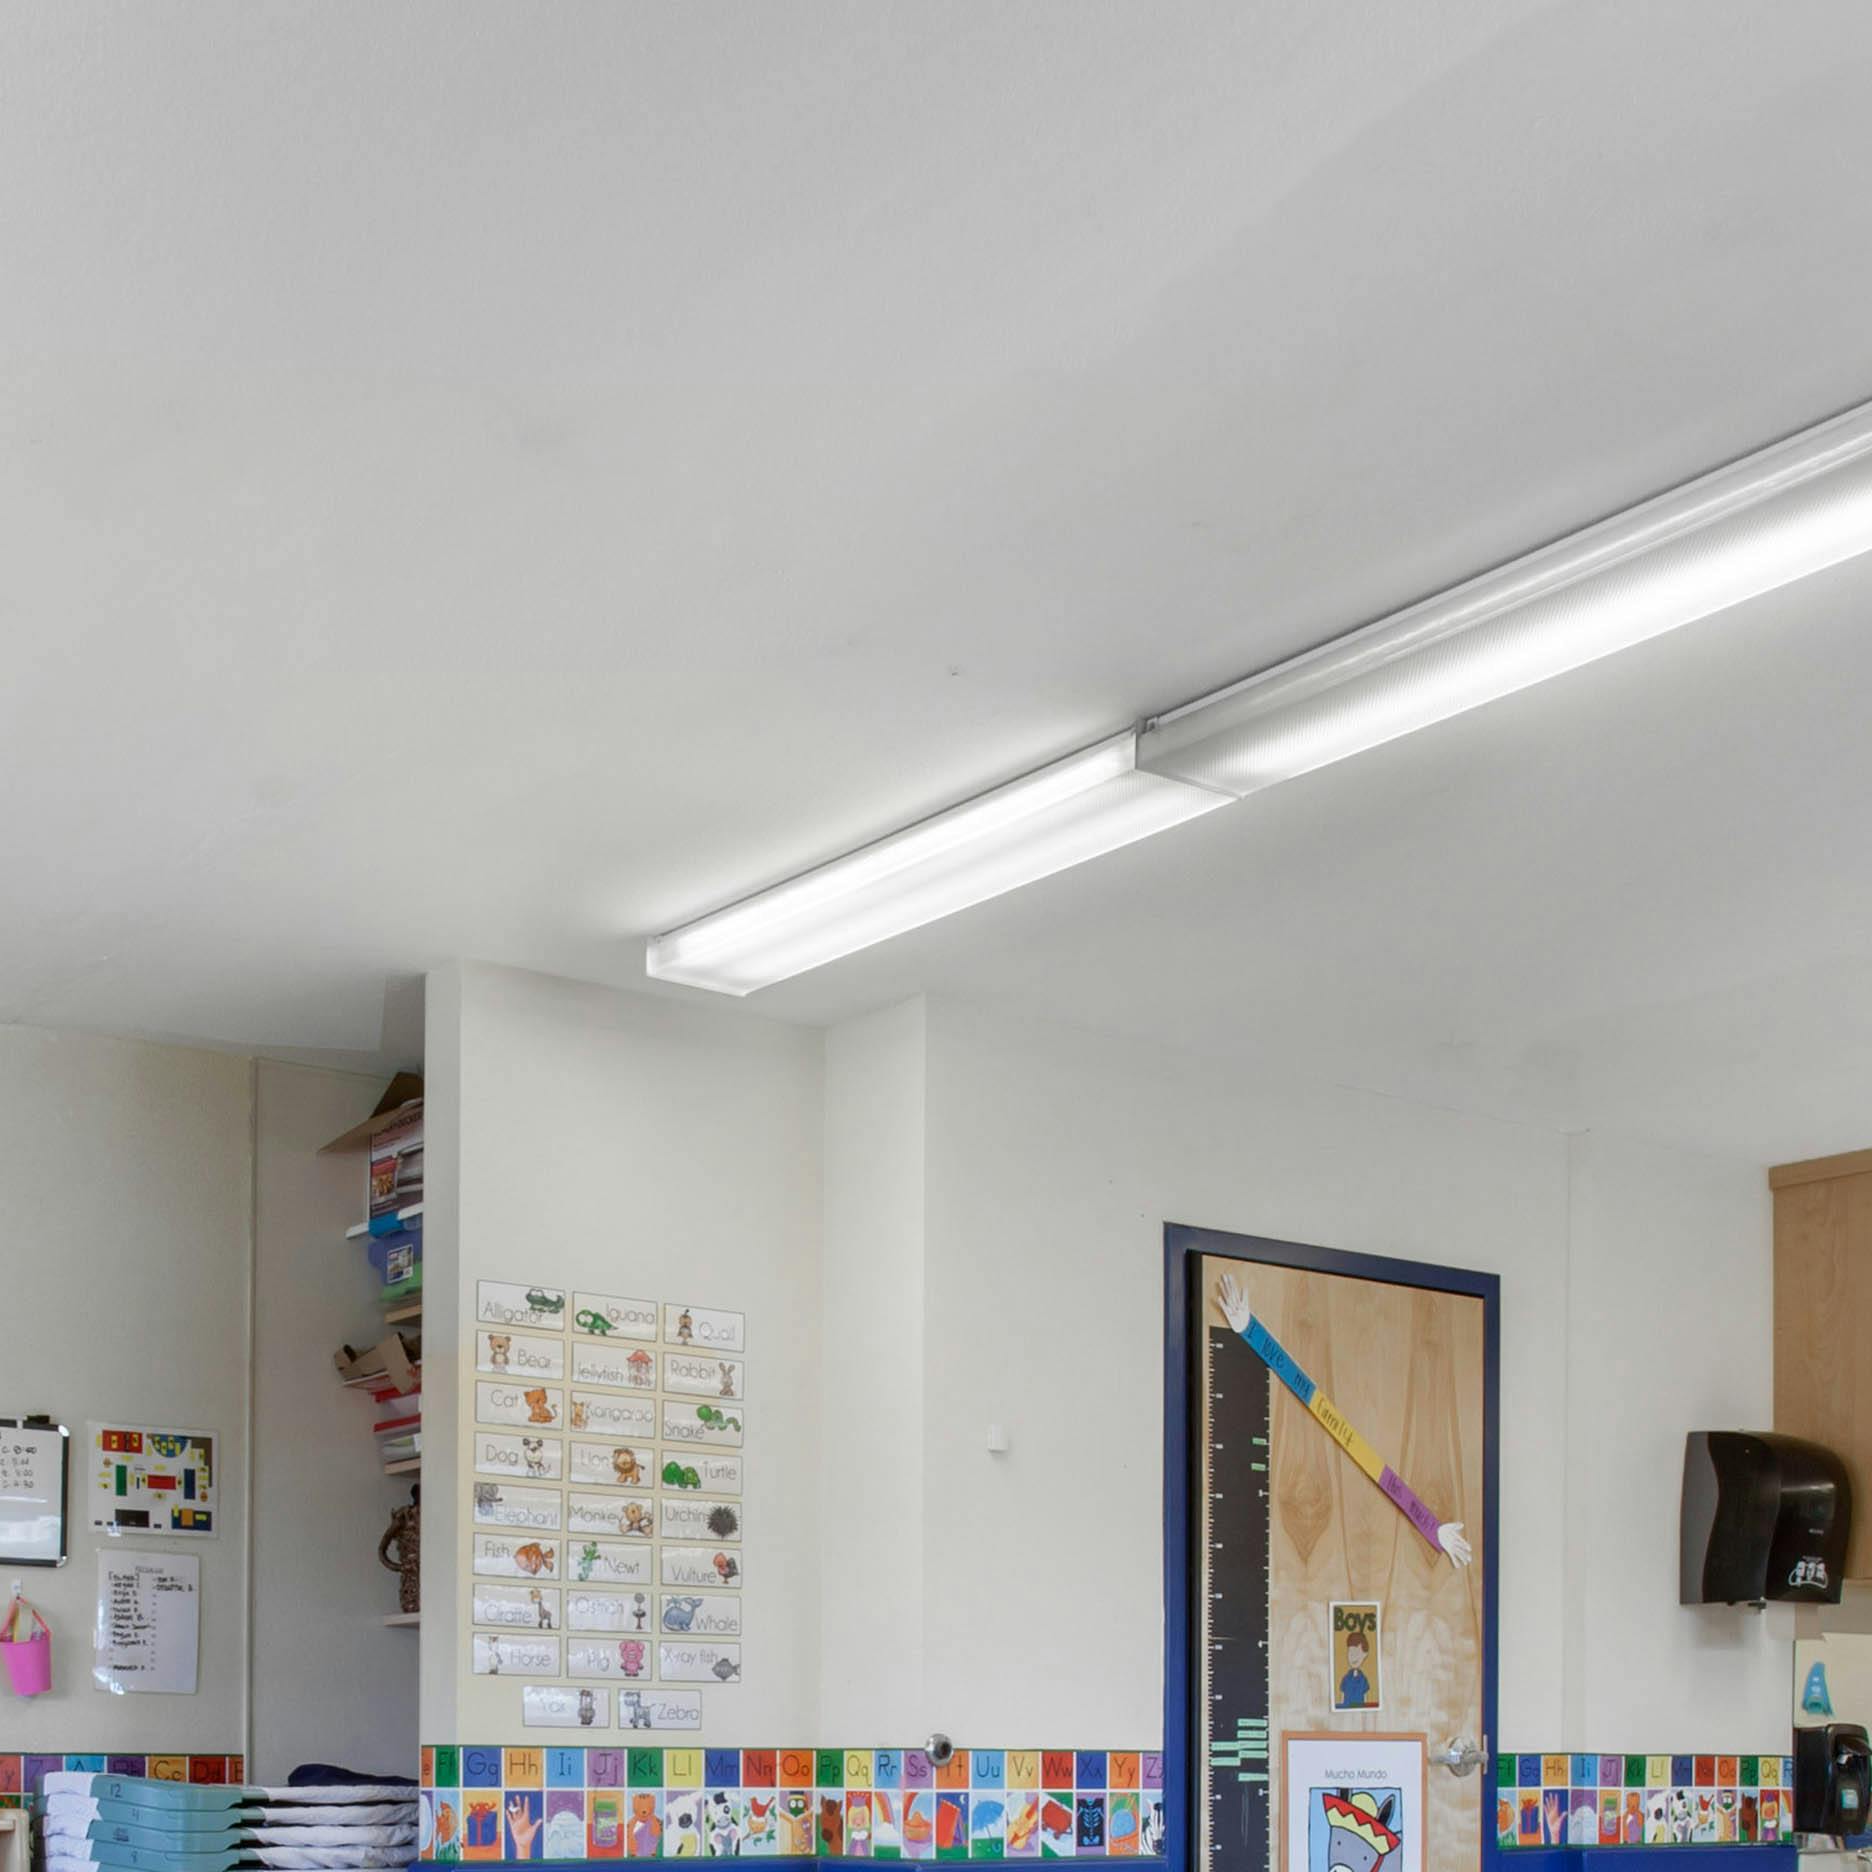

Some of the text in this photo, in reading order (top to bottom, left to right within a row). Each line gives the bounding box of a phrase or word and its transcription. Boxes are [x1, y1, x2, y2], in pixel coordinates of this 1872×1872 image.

[483, 1301, 542, 1323] Alligator
[606, 1305, 655, 1326] Iguana
[518, 1348, 550, 1368] Bear
[491, 1388, 518, 1408] Cat
[665, 1419, 704, 1440] Snake
[486, 1444, 518, 1466] Dog
[704, 1460, 736, 1481] Turtle
[495, 1505, 557, 1527] Elephant
[570, 1505, 622, 1527] Monkey
[665, 1507, 707, 1523] Urchin
[672, 1566, 716, 1584] Vulture
[696, 1616, 738, 1632] Whale
[1334, 1605, 1376, 1639] Boys
[510, 1649, 550, 1668] Horse
[657, 1704, 698, 1721] Zebra
[467, 1752, 499, 1785] Gg
[509, 1753, 538, 1775] Hh
[593, 1753, 617, 1785] Jj
[633, 1753, 658, 1776] Kk
[782, 1754, 809, 1776] Oo
[820, 1755, 840, 1781] Pp
[847, 1755, 872, 1786] Qq
[878, 1755, 897, 1777] Rr
[907, 1755, 928, 1777] Ss
[977, 1755, 1003, 1777] Uu
[1012, 1755, 1034, 1777] Vv
[1045, 1756, 1073, 1777] Ww
[1081, 1756, 1103, 1777] Xx
[1114, 1756, 1136, 1783] Yy
[1325, 1769, 1387, 1780] Mucho Mundo
